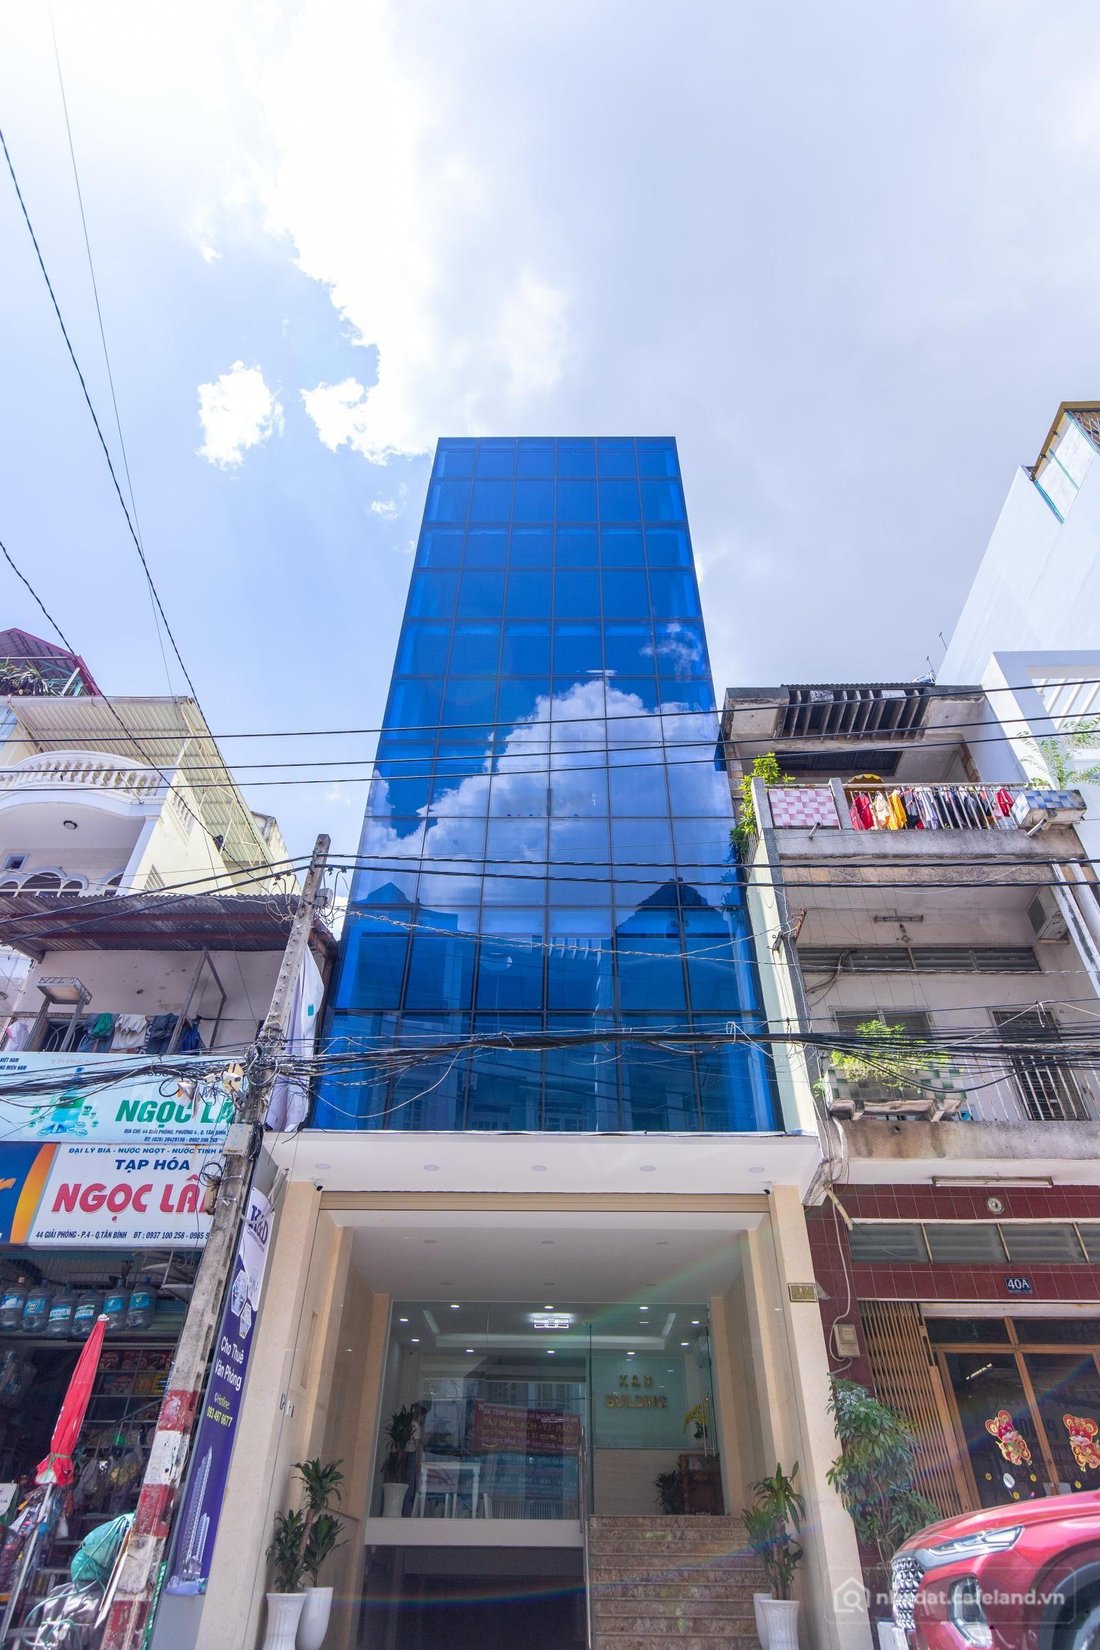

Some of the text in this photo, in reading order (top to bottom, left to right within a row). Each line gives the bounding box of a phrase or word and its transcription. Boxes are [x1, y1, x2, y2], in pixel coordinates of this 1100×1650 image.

[115, 1098, 235, 1128] NGỌC LÂ
[115, 1157, 190, 1173] TẠP HÓA
[52, 1183, 153, 1223] NGỌC
[44, 1228, 56, 1238] GIẢI
[57, 1229, 77, 1238] PHÓNG
[95, 1229, 112, 1239] Q.TÂN
[113, 1230, 128, 1238] BÌNH
[1007, 1279, 1030, 1289] 40A
[221, 1336, 245, 1364] Cho Thuê
[224, 1365, 242, 1391] Phòng
